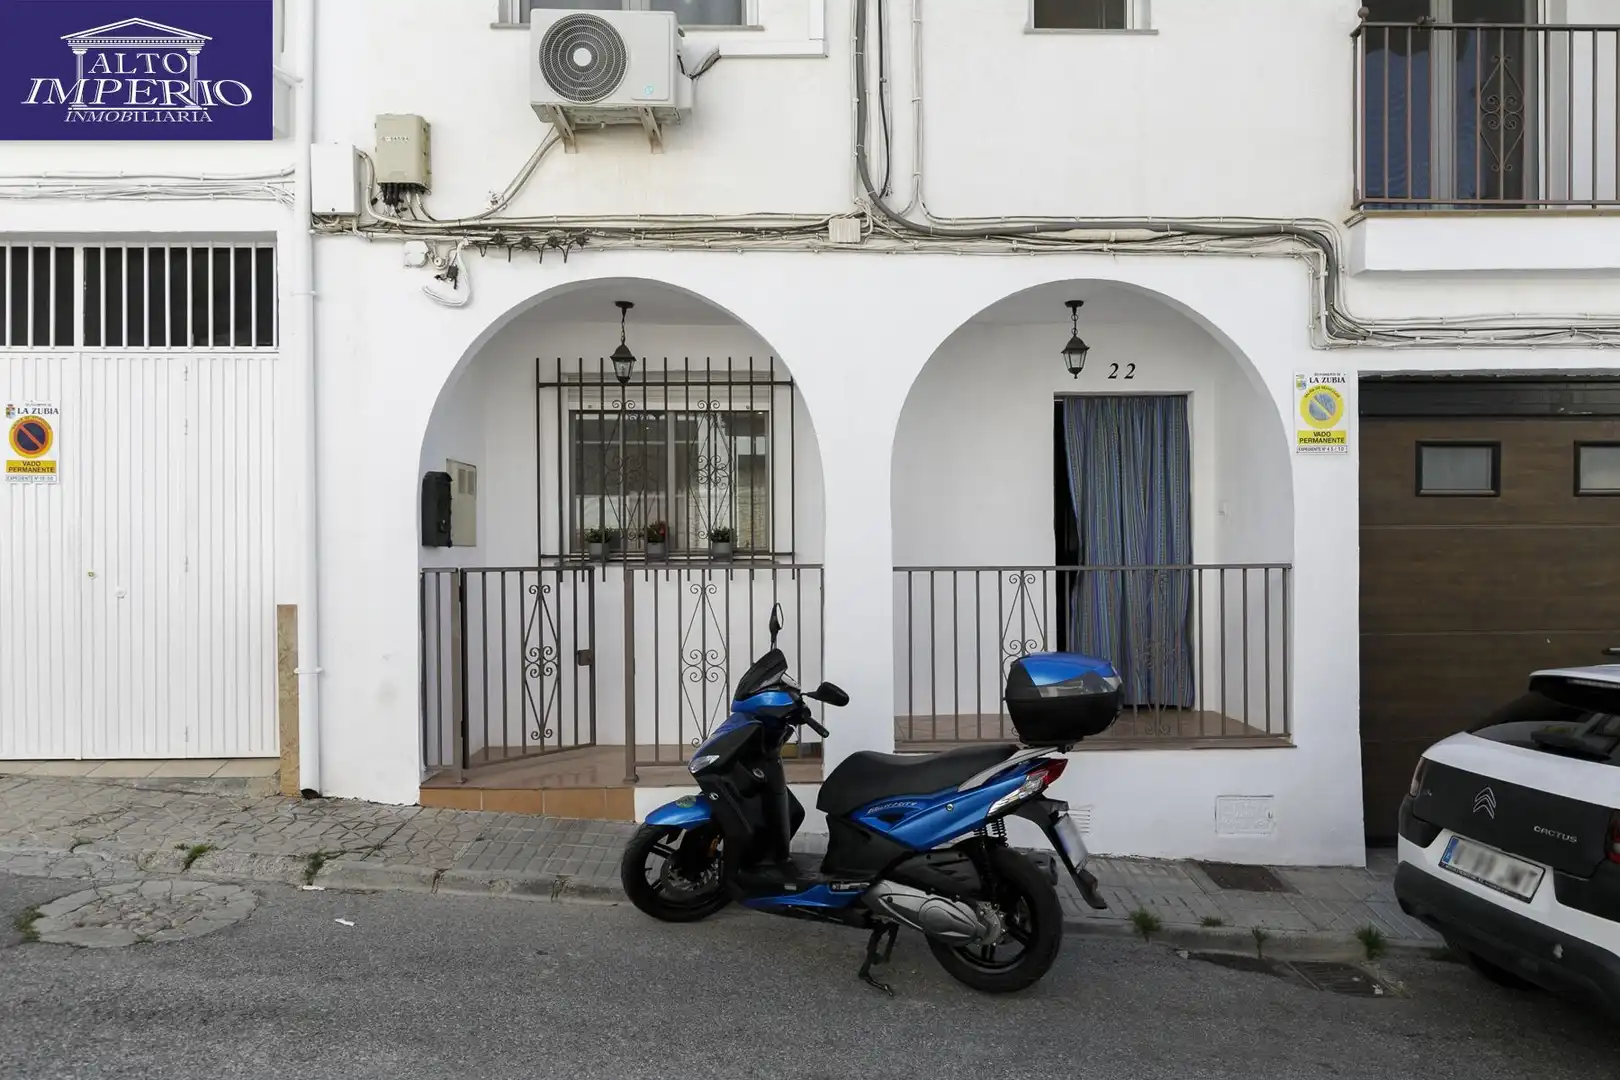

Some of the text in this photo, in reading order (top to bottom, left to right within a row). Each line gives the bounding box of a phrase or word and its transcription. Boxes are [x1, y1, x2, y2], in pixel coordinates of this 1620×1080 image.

[1107, 362, 1136, 380] 22
[17, 407, 60, 415] LA ZUBIA
[1533, 824, 1578, 843] CACTUS
